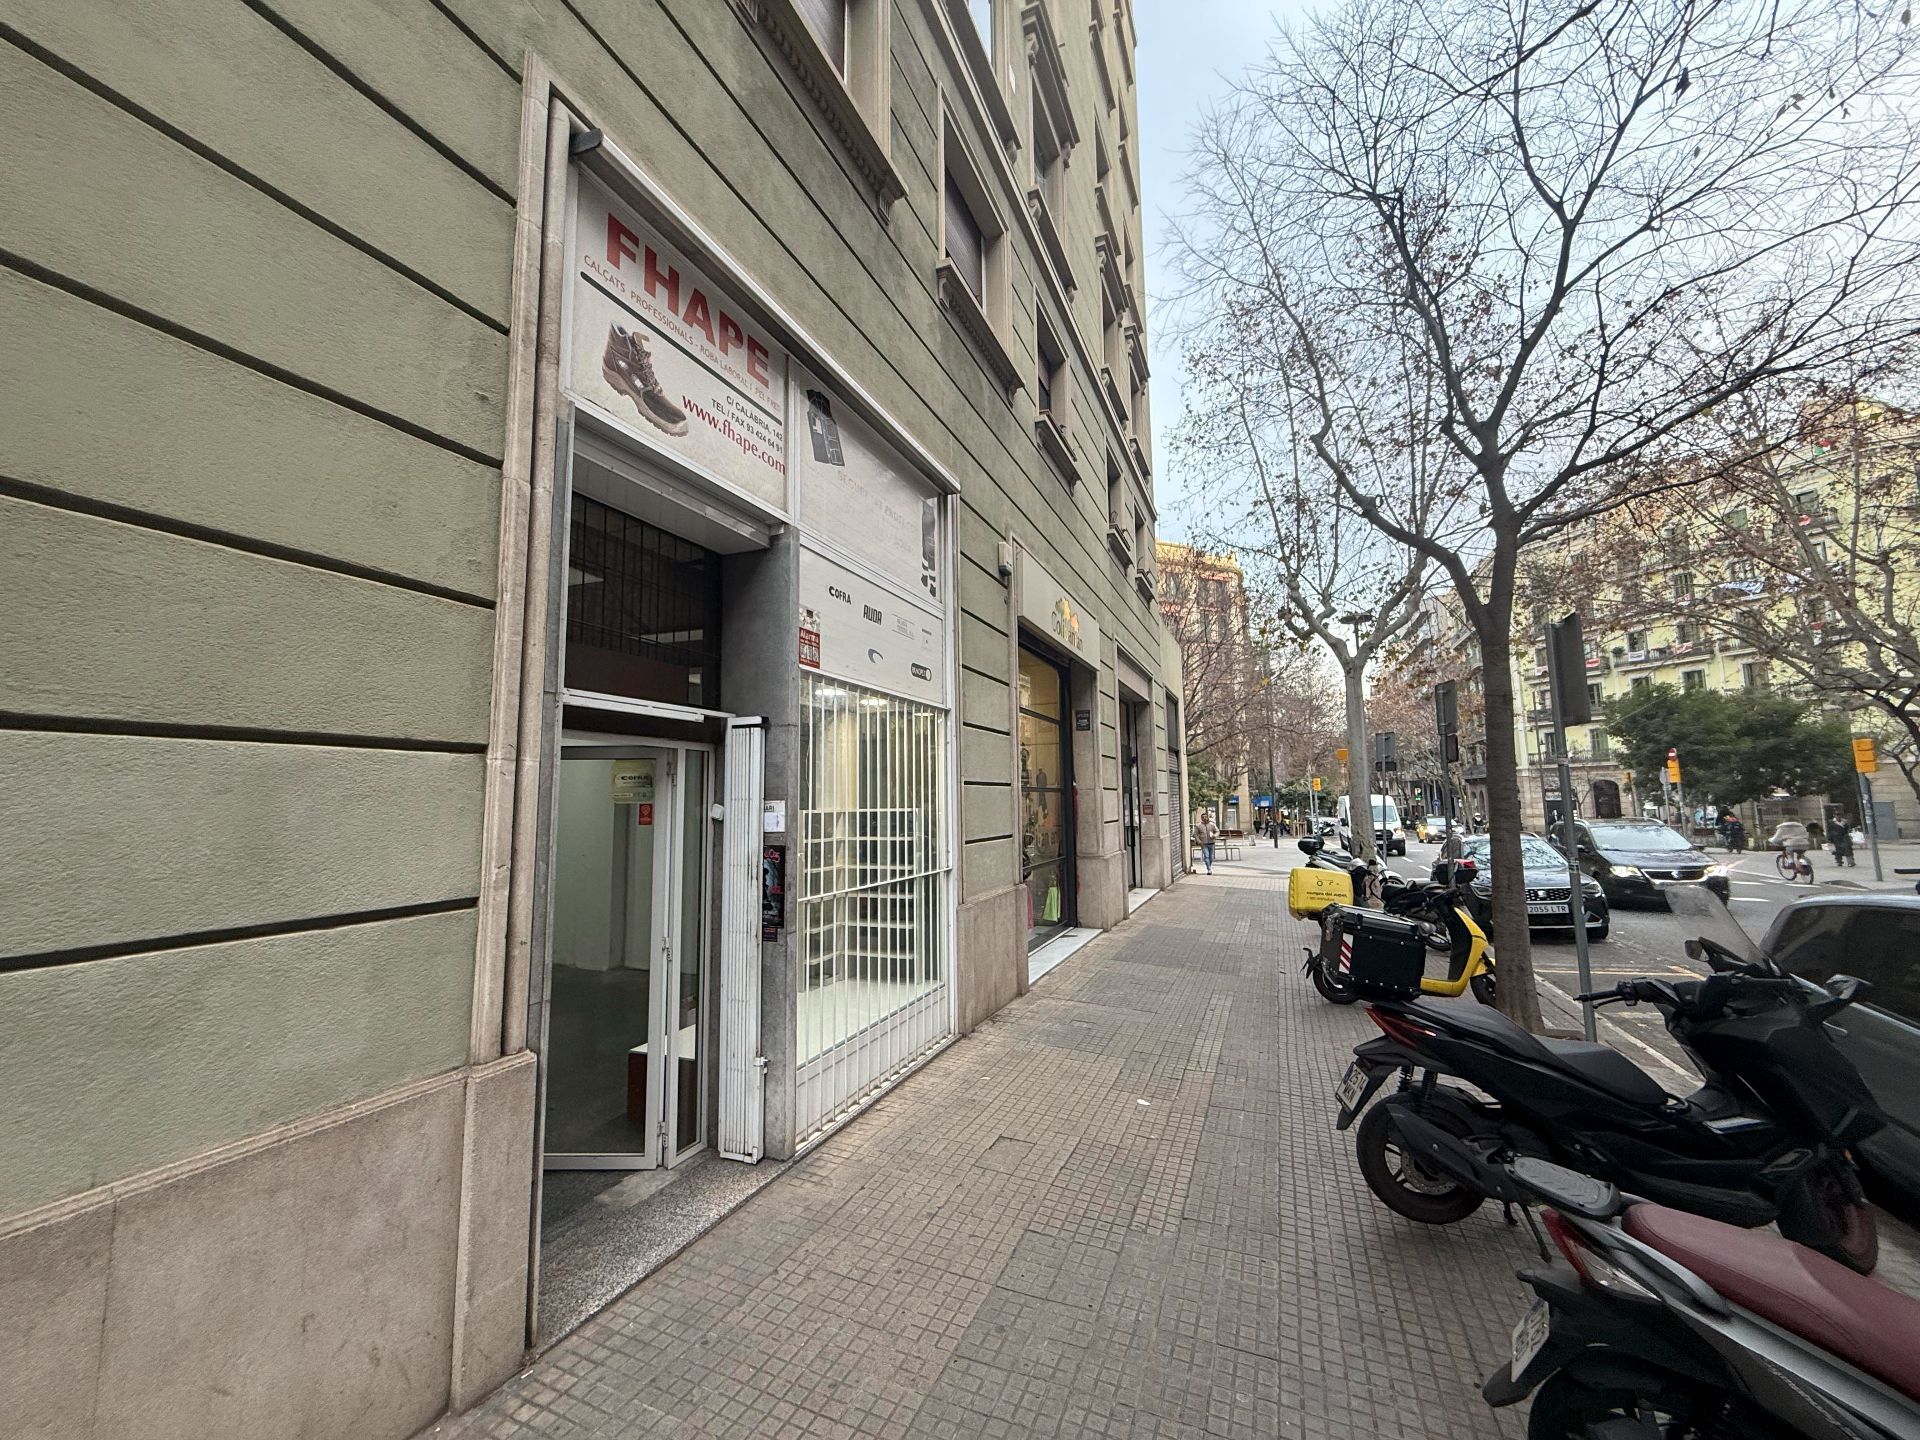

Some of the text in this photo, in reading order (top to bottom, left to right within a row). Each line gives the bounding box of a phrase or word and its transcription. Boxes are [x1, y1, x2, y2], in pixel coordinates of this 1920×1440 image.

[584, 255, 625, 292] CALÇATS
[630, 290, 694, 346] PROFESSIONALS
[701, 345, 719, 367] ROBA
[607, 212, 769, 389] FHAPE
[682, 394, 786, 476] www.fhape.com
[712, 398, 726, 415] TEL
[731, 412, 746, 428] FAX
[746, 422, 755, 434] 93
[755, 430, 767, 443] 424
[767, 437, 775, 449] 64
[775, 444, 783, 454] 91
[726, 395, 734, 406] C/
[773, 429, 783, 441] 142
[828, 585, 852, 605] COFRA
[1528, 905, 1568, 913] 2055 LTR
